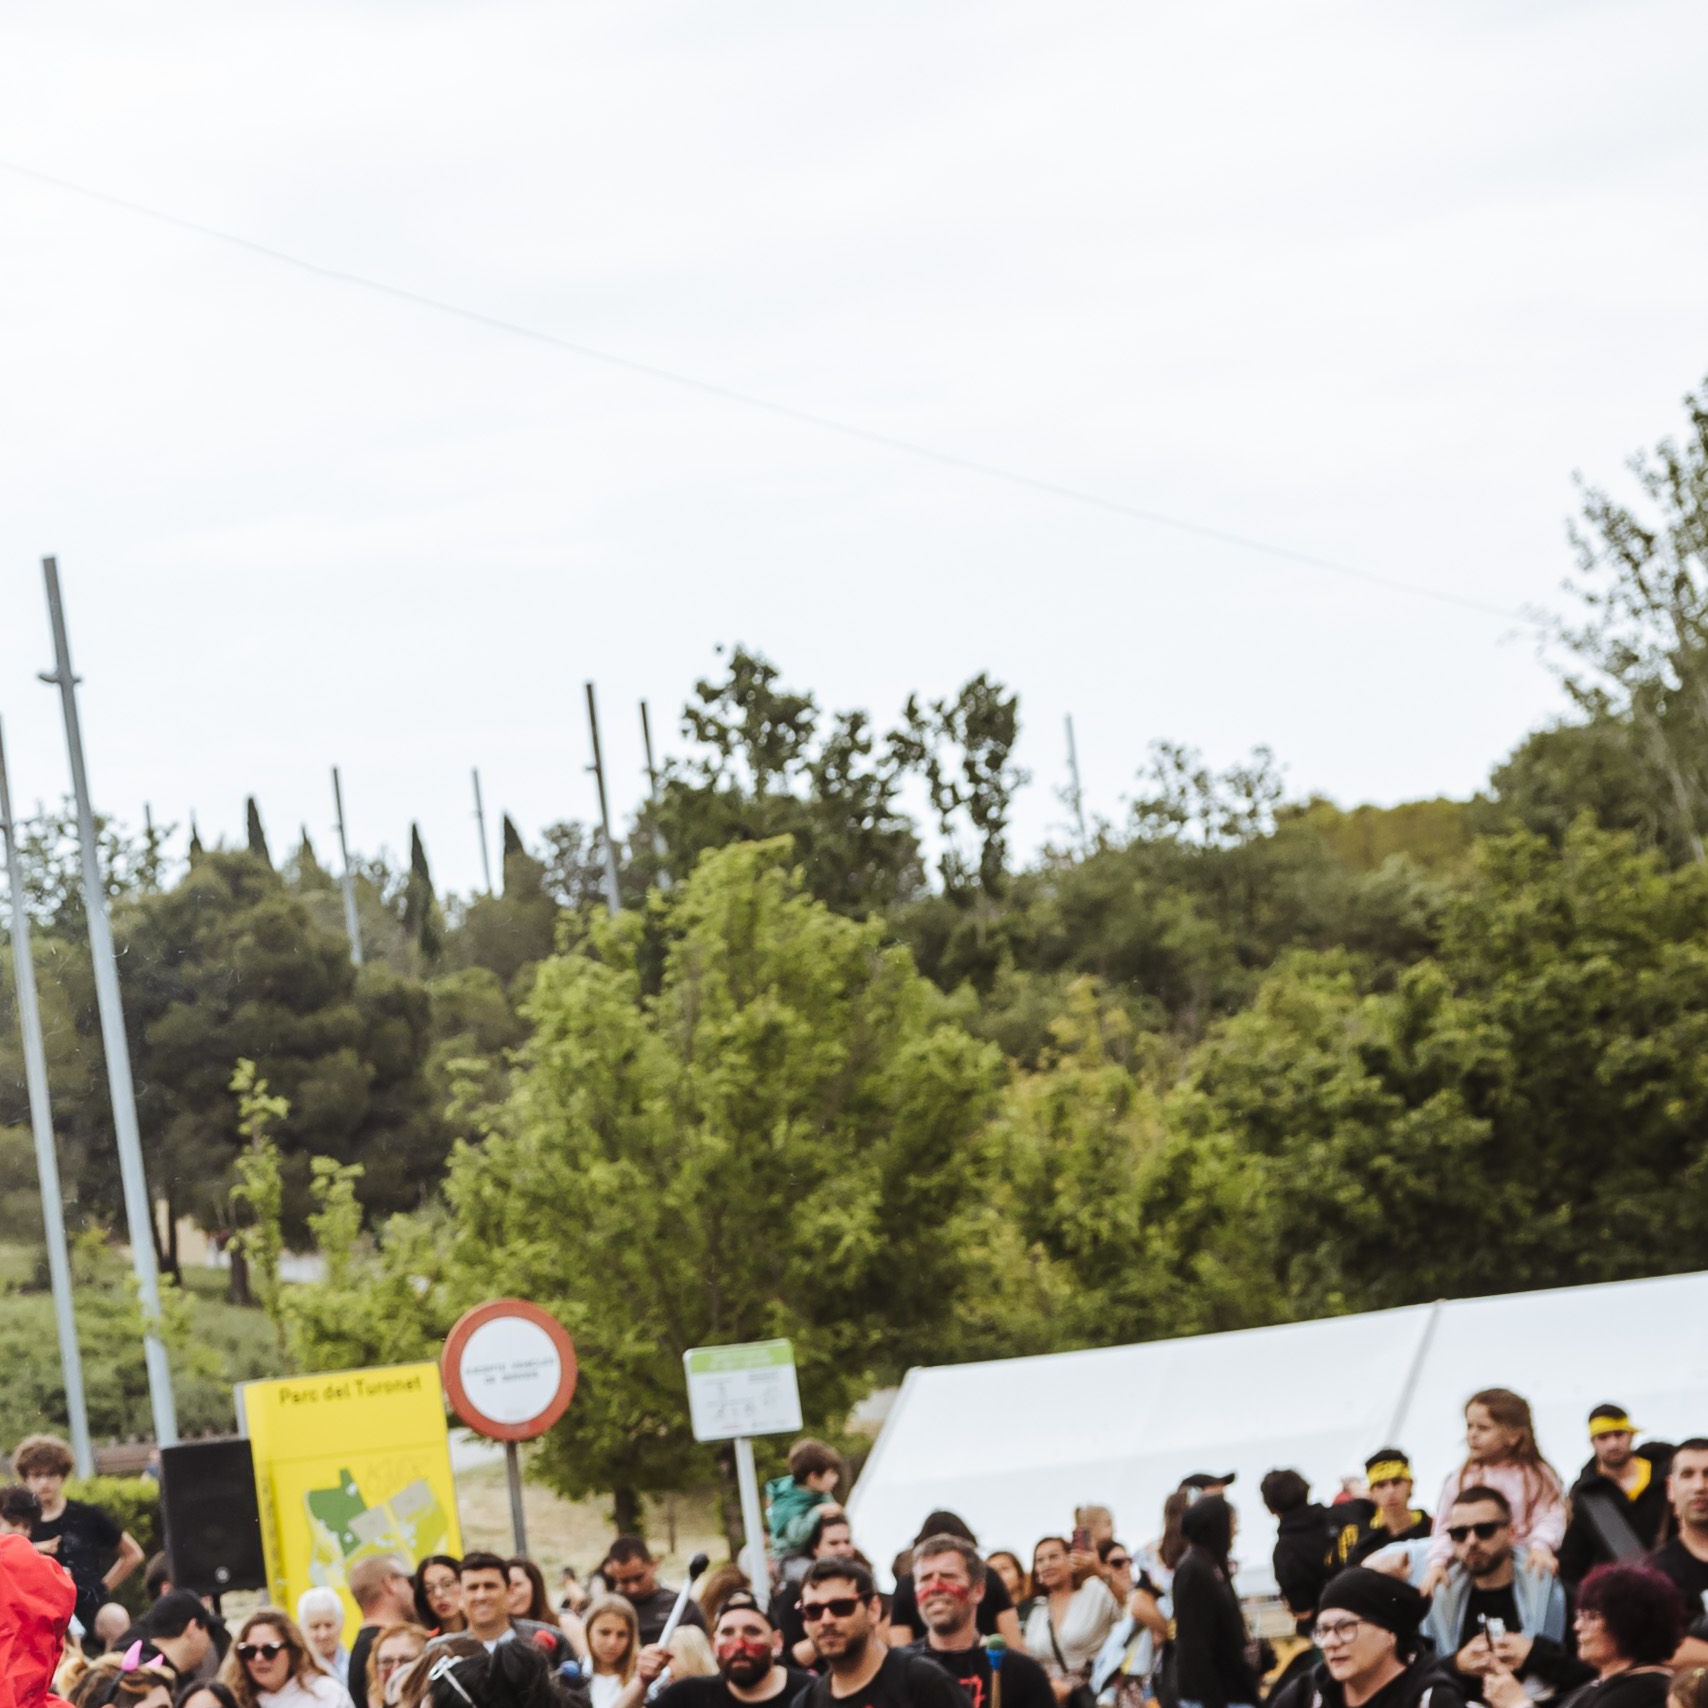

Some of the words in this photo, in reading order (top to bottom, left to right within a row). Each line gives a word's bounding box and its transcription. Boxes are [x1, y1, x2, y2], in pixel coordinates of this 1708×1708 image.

[278, 1387, 317, 1406] Parc
[322, 1382, 351, 1401] del
[354, 1376, 422, 1397] Turonet
